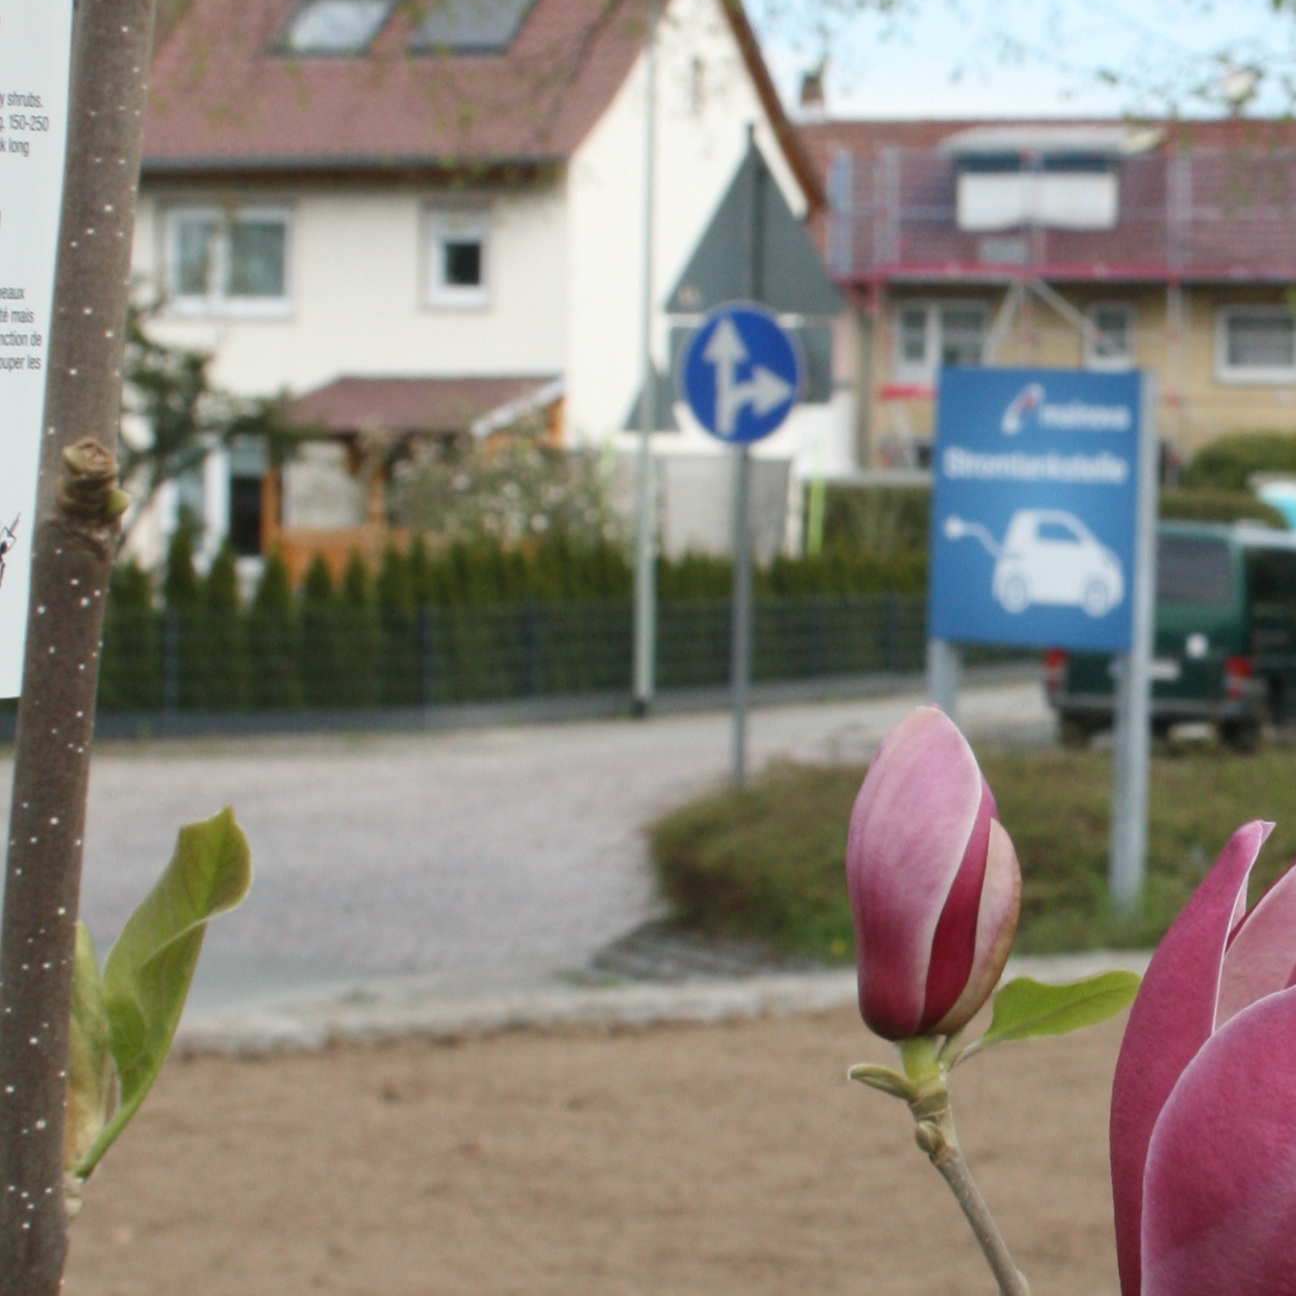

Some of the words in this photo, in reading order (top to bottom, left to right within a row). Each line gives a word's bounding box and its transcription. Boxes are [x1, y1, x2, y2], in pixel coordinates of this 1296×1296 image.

[9, 114, 49, 132] 150-250
[8, 137, 29, 158] long
[10, 307, 34, 323] mais
[30, 332, 42, 347] de
[26, 354, 41, 370] les
